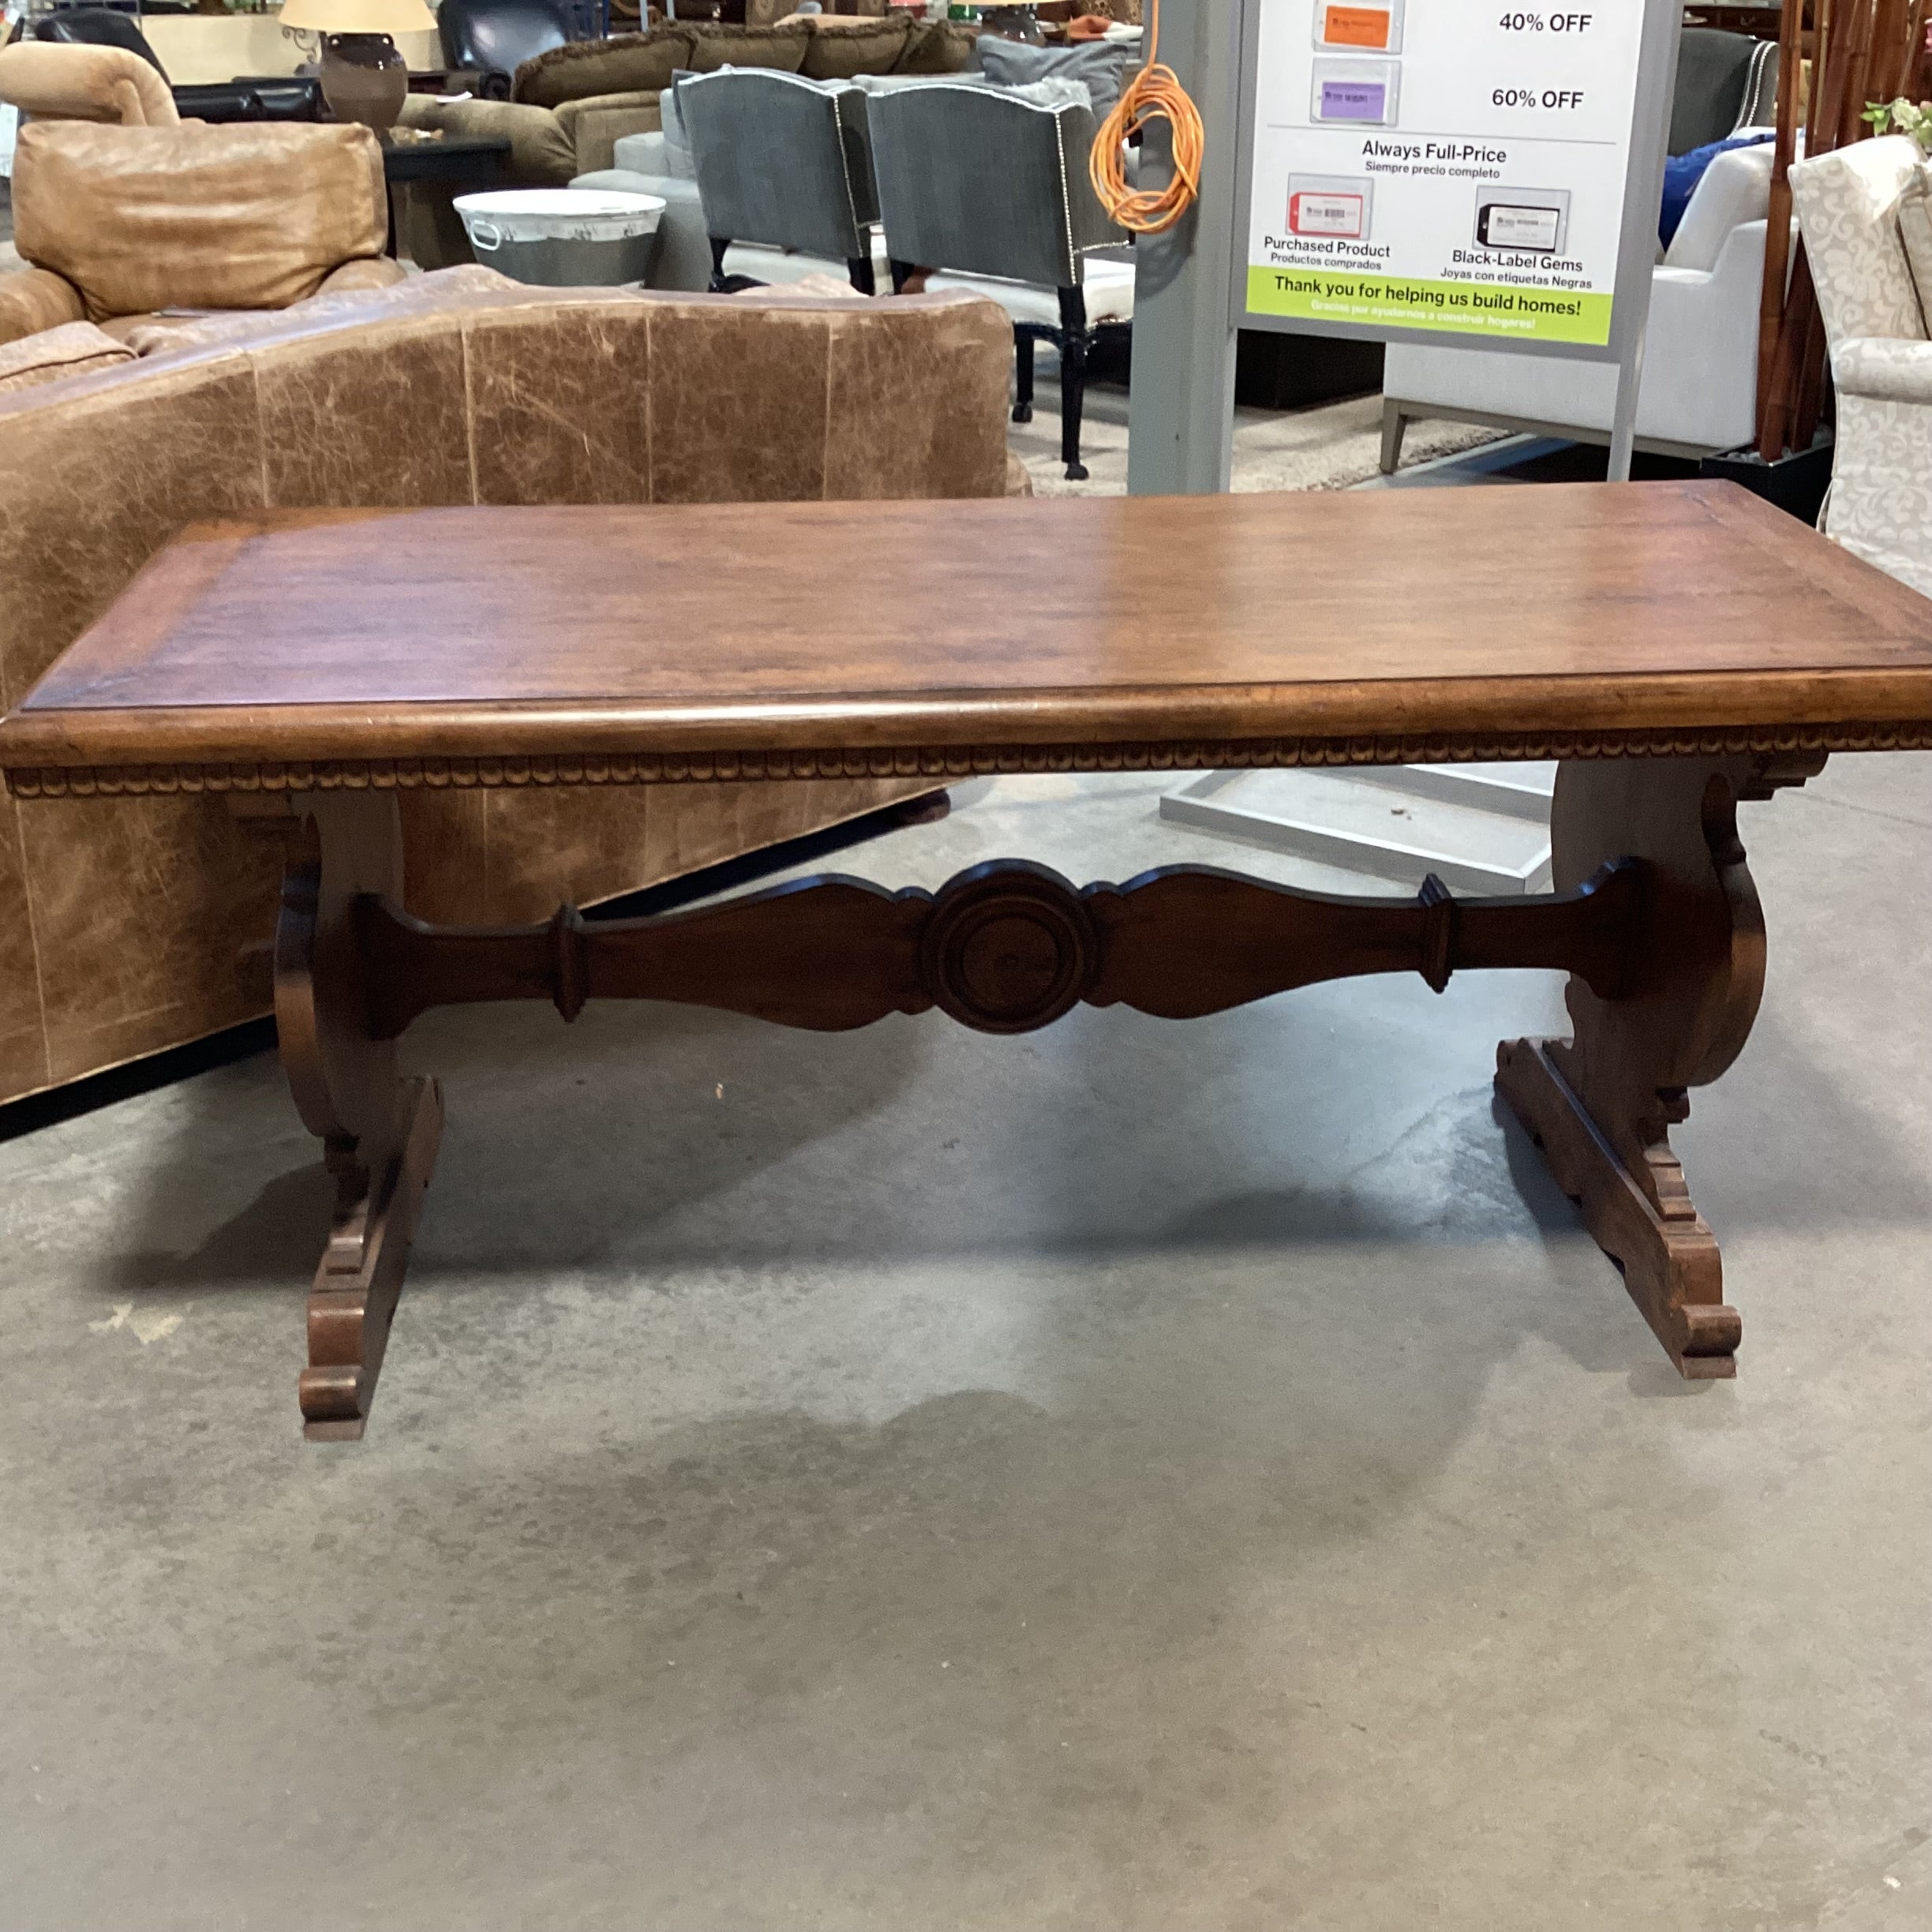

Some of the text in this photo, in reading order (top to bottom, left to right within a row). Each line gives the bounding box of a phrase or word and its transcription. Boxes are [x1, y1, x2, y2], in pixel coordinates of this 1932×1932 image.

[1500, 13, 1592, 32] 40% OFF
[1492, 89, 1584, 109] 60% OFF
[1362, 140, 1507, 163] Always Full-Price
[1365, 161, 1500, 179] Siempre precio completo
[1264, 237, 1391, 258] Purchased Product
[1271, 253, 1381, 271] Productos comprados
[1453, 250, 1582, 272] Black-Label Gems
[1440, 268, 1592, 290] Joyas con etiquetas Negras
[1275, 276, 1581, 315] Thank you for helping us build homes!
[1352, 304, 1368, 316] por
[1437, 309, 1484, 324] construir
